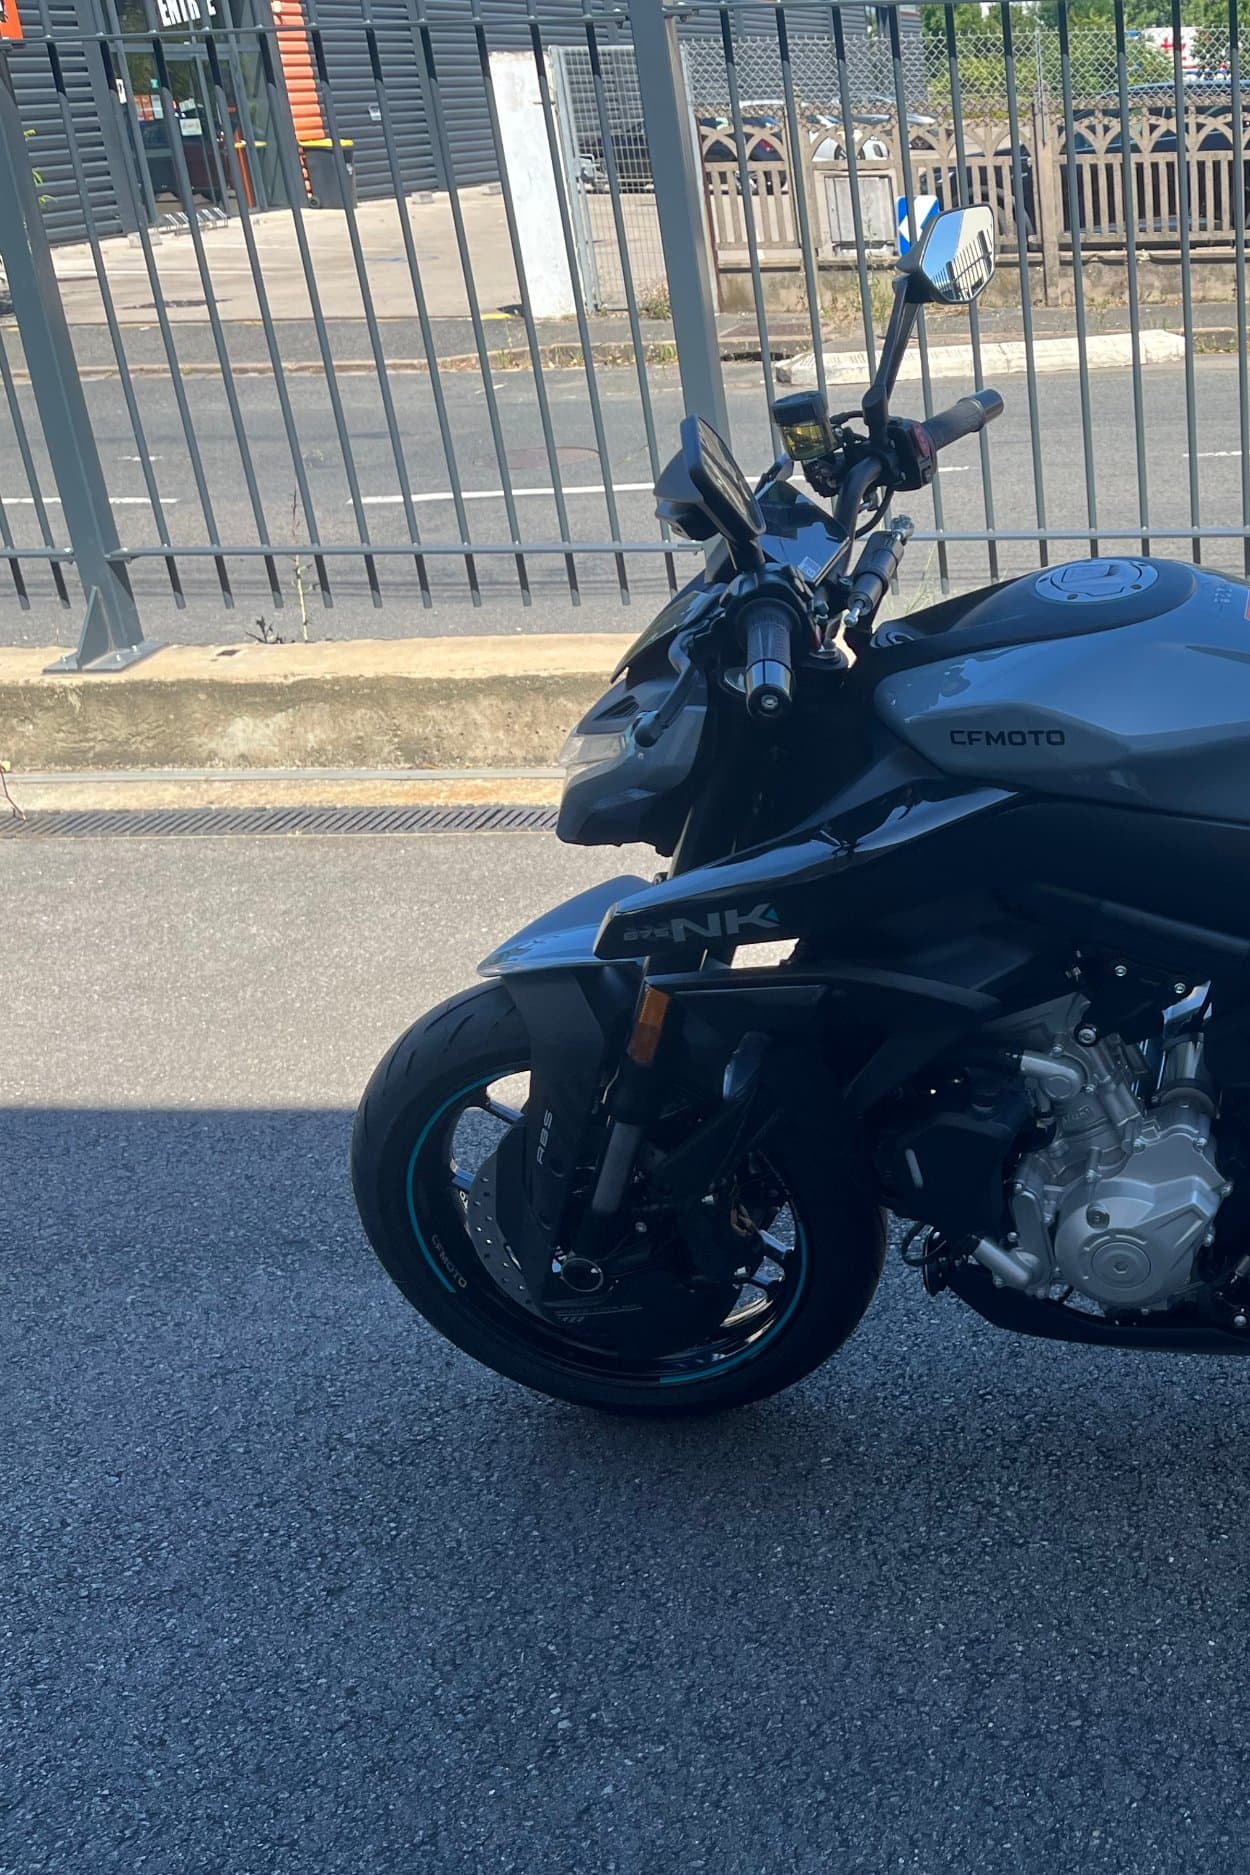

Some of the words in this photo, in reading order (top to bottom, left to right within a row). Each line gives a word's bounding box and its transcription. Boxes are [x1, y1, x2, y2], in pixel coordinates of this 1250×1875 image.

[157, 0, 217, 27] ENTR
[950, 729, 1065, 746] CFMOTO
[671, 902, 782, 943] NK
[536, 1109, 553, 1165] ABS
